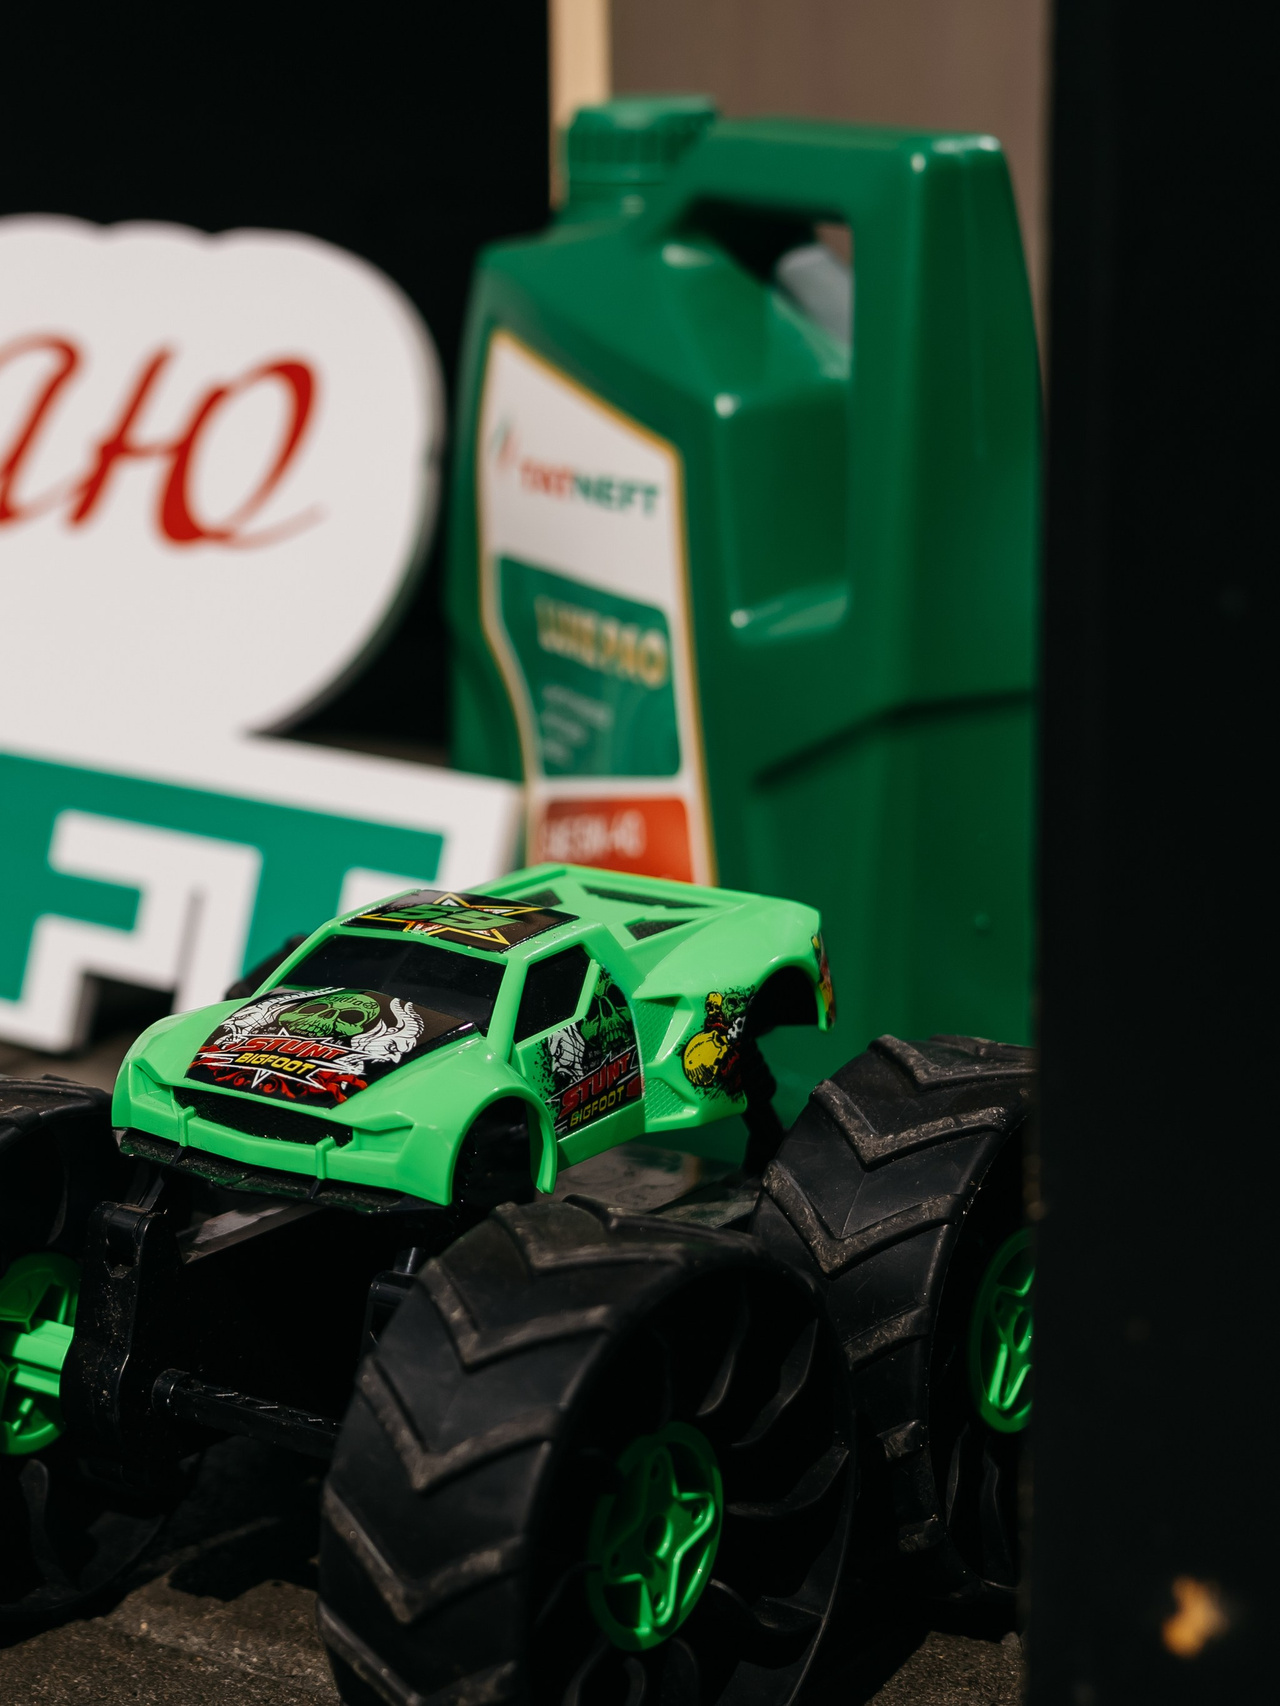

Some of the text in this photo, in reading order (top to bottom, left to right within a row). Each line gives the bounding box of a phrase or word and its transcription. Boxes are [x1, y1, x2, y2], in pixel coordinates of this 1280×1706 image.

[520, 459, 658, 516] TATNEFT
[235, 1052, 317, 1075] BIGFOOT
[237, 1037, 348, 1060] STUNT
[558, 1053, 631, 1119] STUNT
[570, 1085, 625, 1127] BIGFOOT
